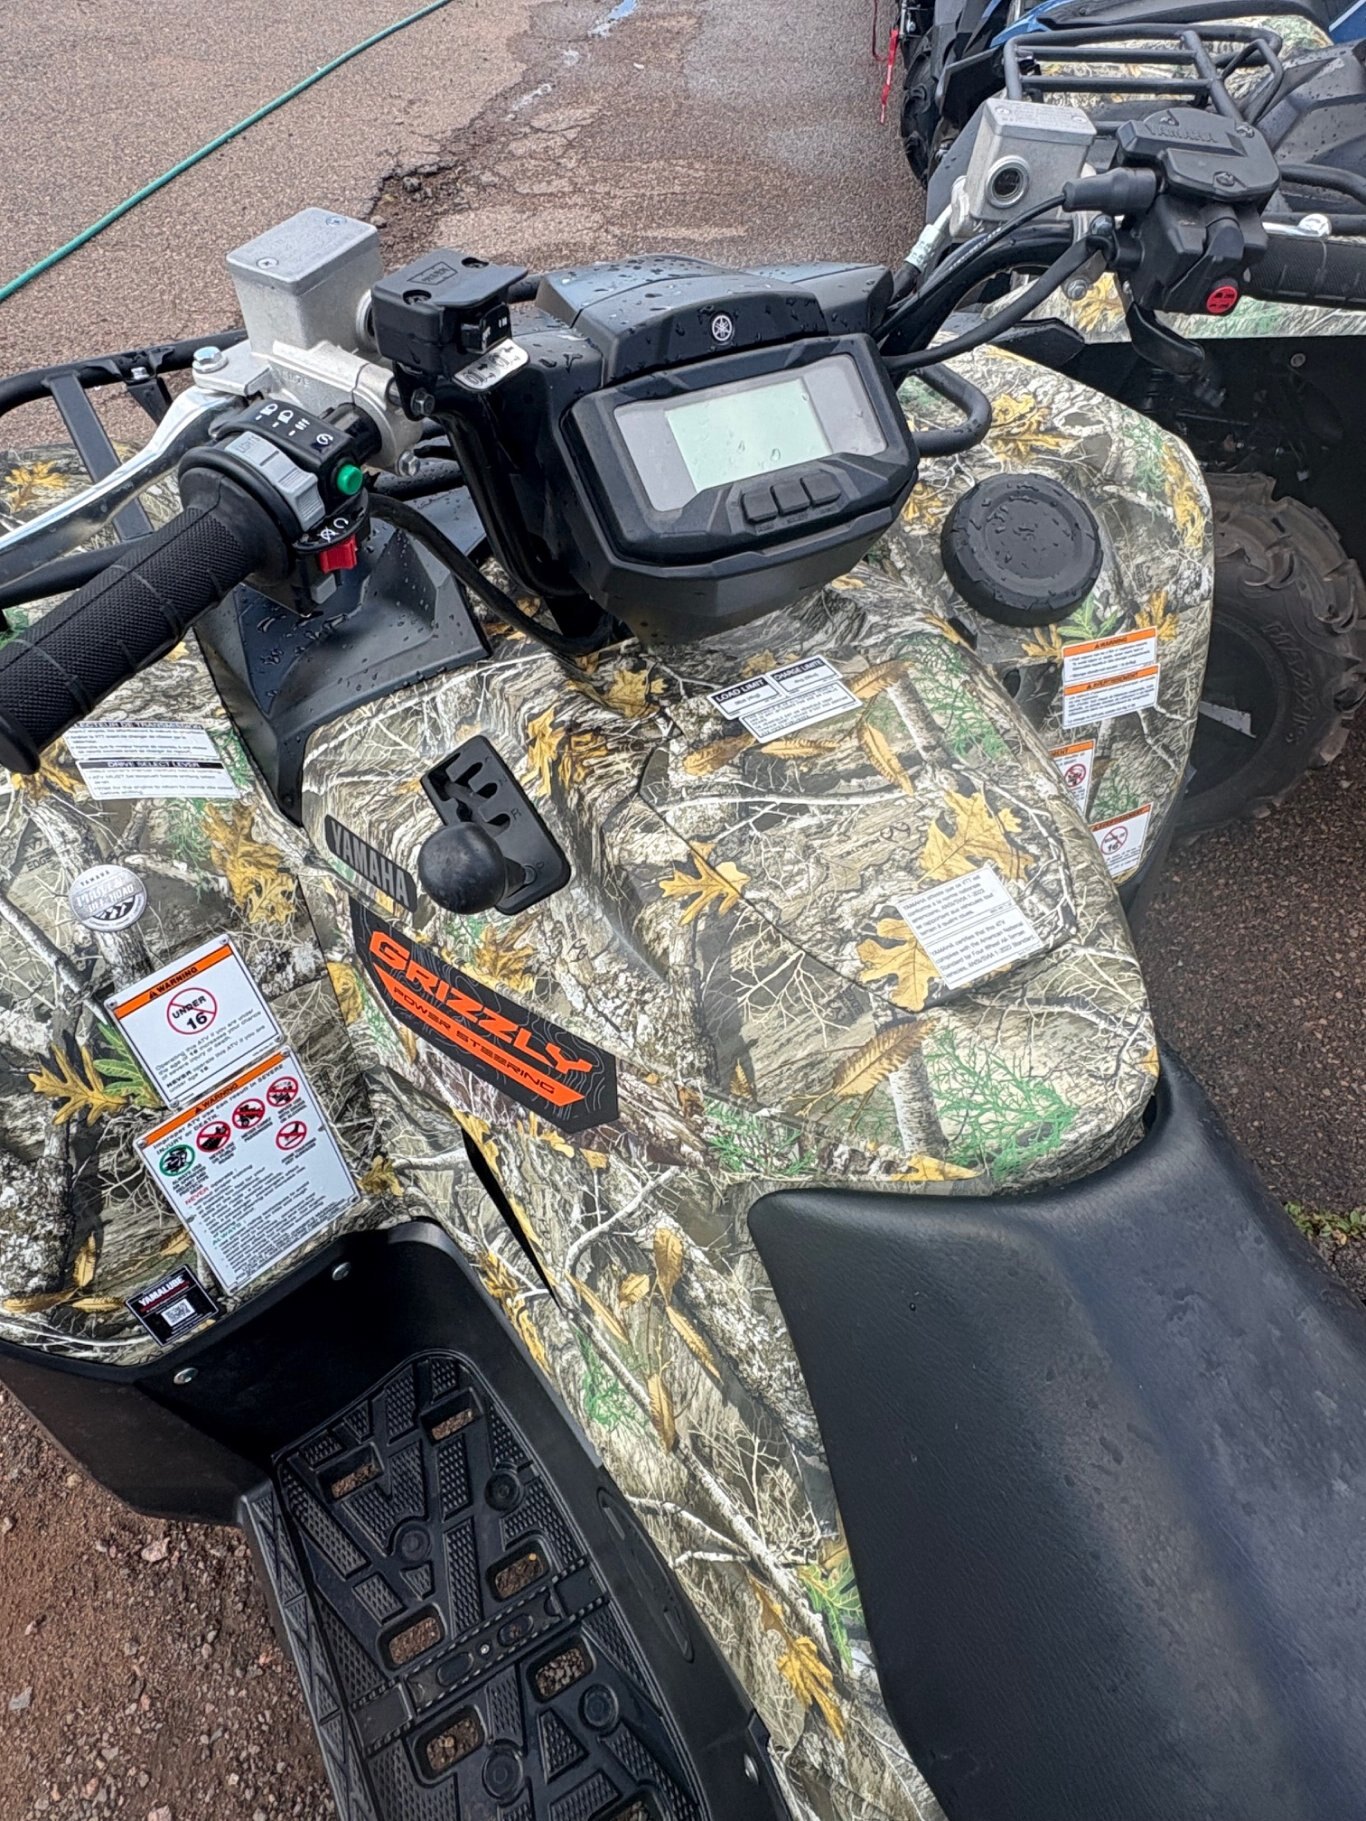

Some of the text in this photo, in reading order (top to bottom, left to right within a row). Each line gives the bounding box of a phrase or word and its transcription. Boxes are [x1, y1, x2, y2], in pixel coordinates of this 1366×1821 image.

[773, 666, 801, 680] CHARGE
[801, 658, 824, 671] LIMITE
[715, 689, 741, 703] LOAD
[741, 679, 765, 694] LIMIT
[510, 808, 523, 821] R
[26, 855, 53, 872] EDGE
[331, 820, 410, 909] YAMAHA
[903, 898, 926, 910] YAMAHA
[931, 943, 954, 955] YAMAHA
[156, 966, 198, 994] WARNING
[171, 995, 208, 1020] UNDER
[369, 930, 593, 1074] GRIZZLY
[186, 1012, 208, 1030] 16
[155, 1051, 187, 1071] Operating
[185, 1044, 197, 1052] this
[197, 1035, 209, 1045] ATV
[215, 1026, 227, 1035] you
[227, 1019, 237, 1027] are
[238, 1009, 253, 1021] under
[393, 985, 556, 1096] POWER STEERING
[153, 1127, 185, 1149] Improper
[187, 1117, 200, 1128] ATV
[202, 1109, 214, 1118] use
[216, 1100, 228, 1110] can
[229, 1086, 249, 1101] result
[258, 1064, 283, 1082] SEVERE
[201, 1082, 238, 1110] WARNING
[156, 1136, 182, 1155] INJURY
[193, 1114, 218, 1131] DEATH.
[185, 1187, 209, 1205] NEVER
[212, 1223, 242, 1246] ALWAYS
[138, 1274, 186, 1306] YAMALUBE
